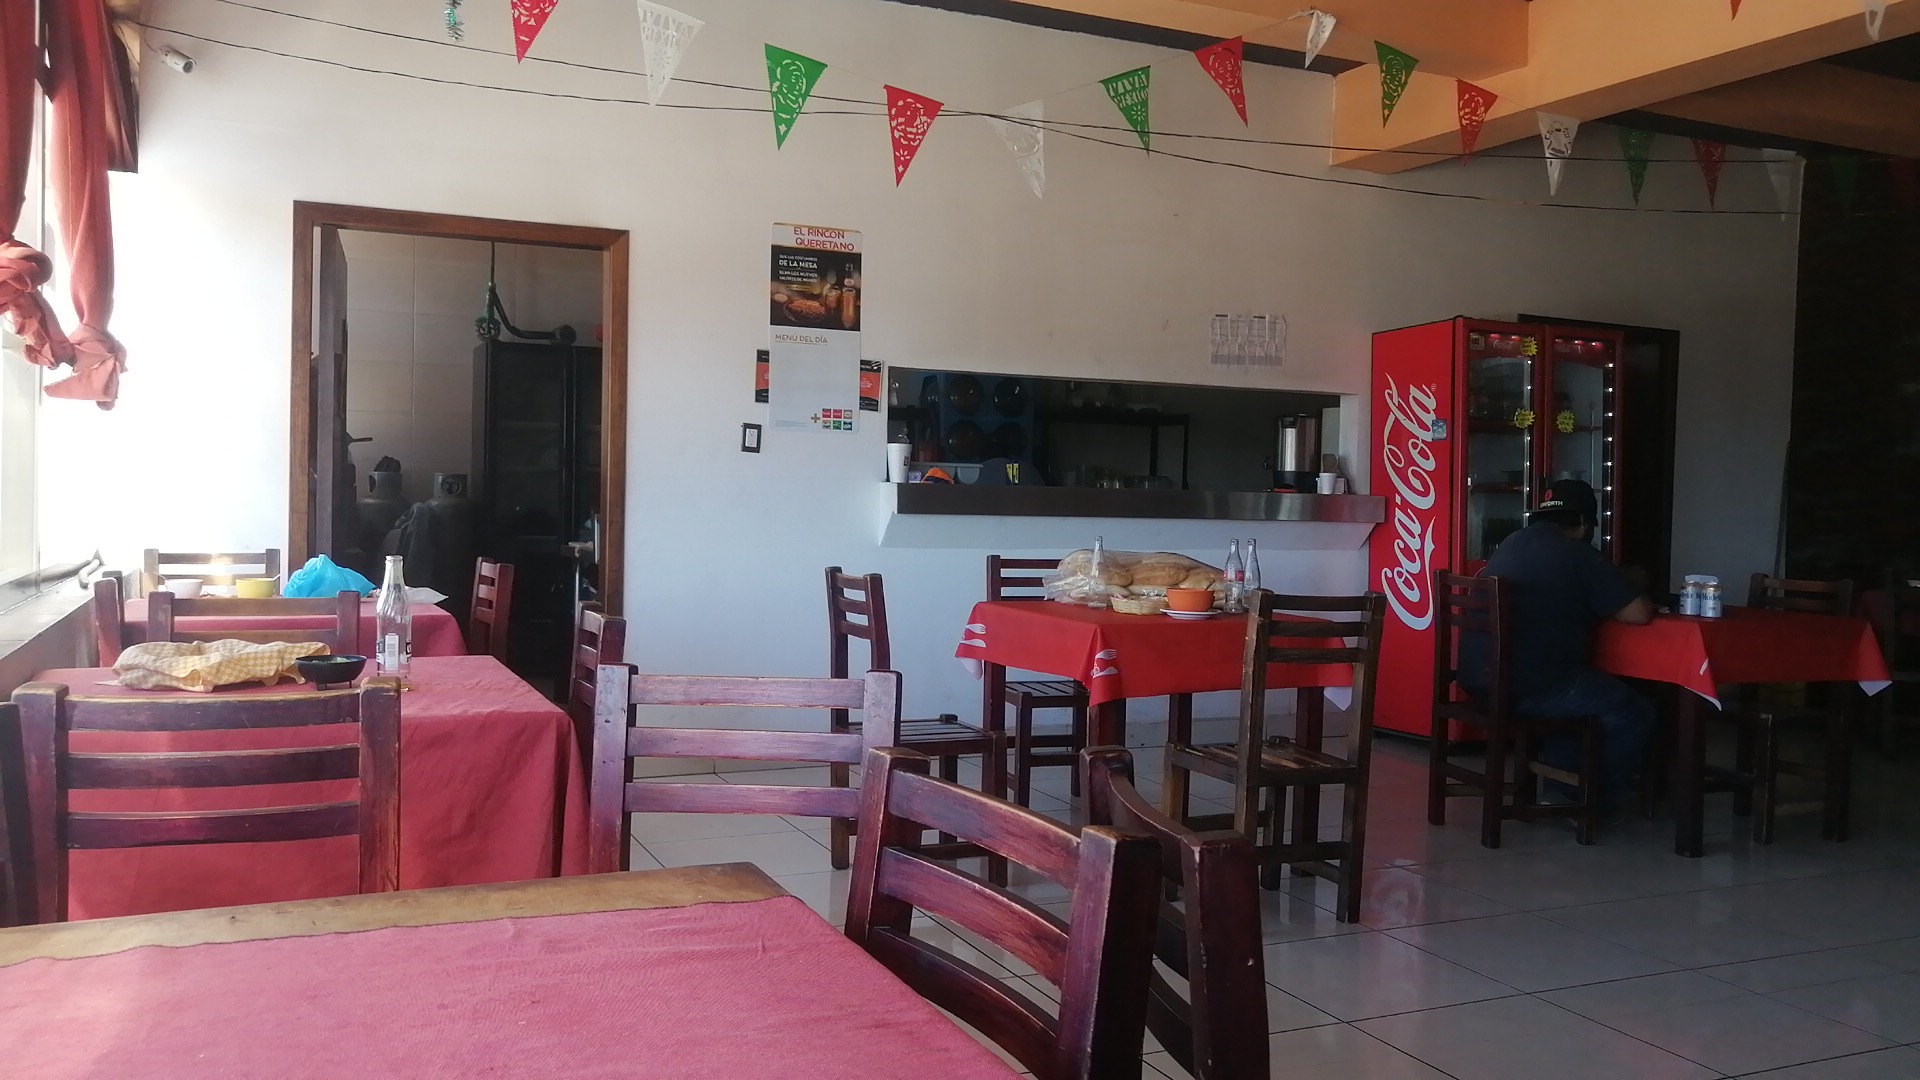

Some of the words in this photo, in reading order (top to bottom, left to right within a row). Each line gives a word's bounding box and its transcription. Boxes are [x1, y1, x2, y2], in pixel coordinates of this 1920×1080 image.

[794, 227, 805, 236] EL
[807, 228, 845, 239] RINCON
[795, 238, 854, 251] QUERETANO
[799, 261, 818, 269] MESA
[799, 335, 813, 343] DEL
[814, 334, 828, 344] DÍA
[1381, 372, 1437, 631] Coca-Cola
